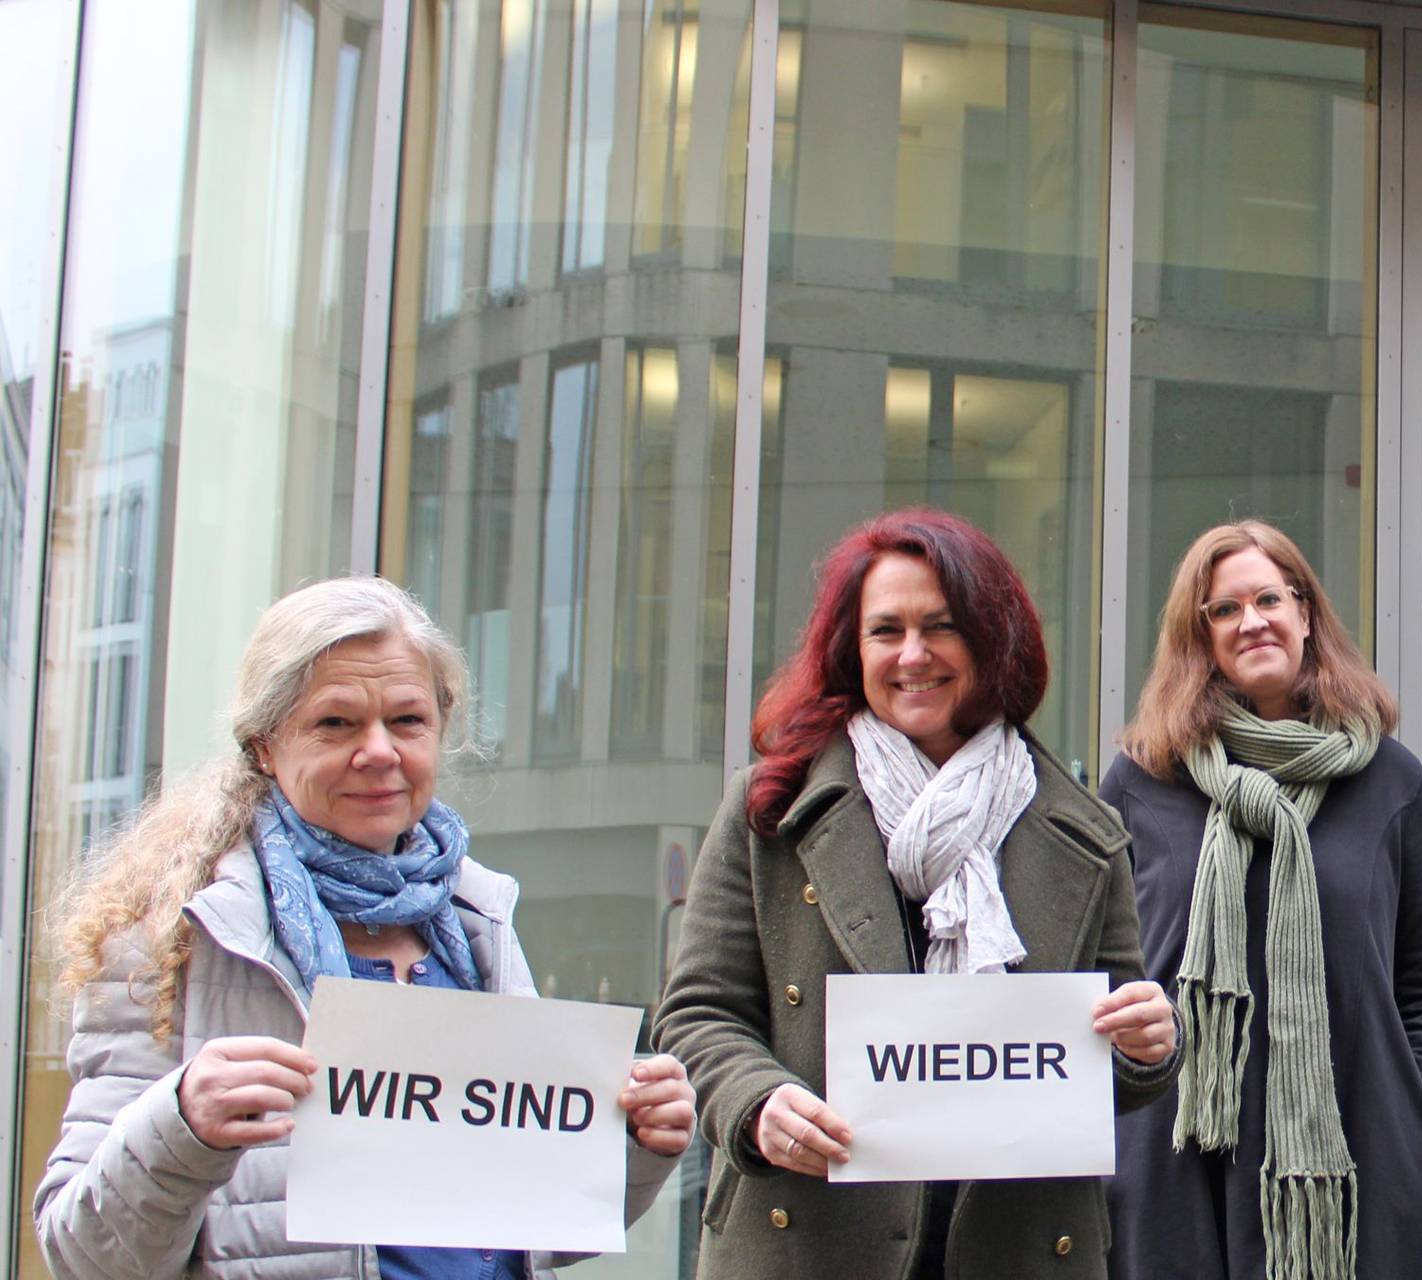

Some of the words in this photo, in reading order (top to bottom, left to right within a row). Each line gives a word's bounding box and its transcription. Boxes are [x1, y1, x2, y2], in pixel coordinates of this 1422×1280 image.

[866, 1043, 1069, 1082] WIEDER
[328, 1066, 442, 1122] WIR
[461, 1078, 595, 1132] SIND
